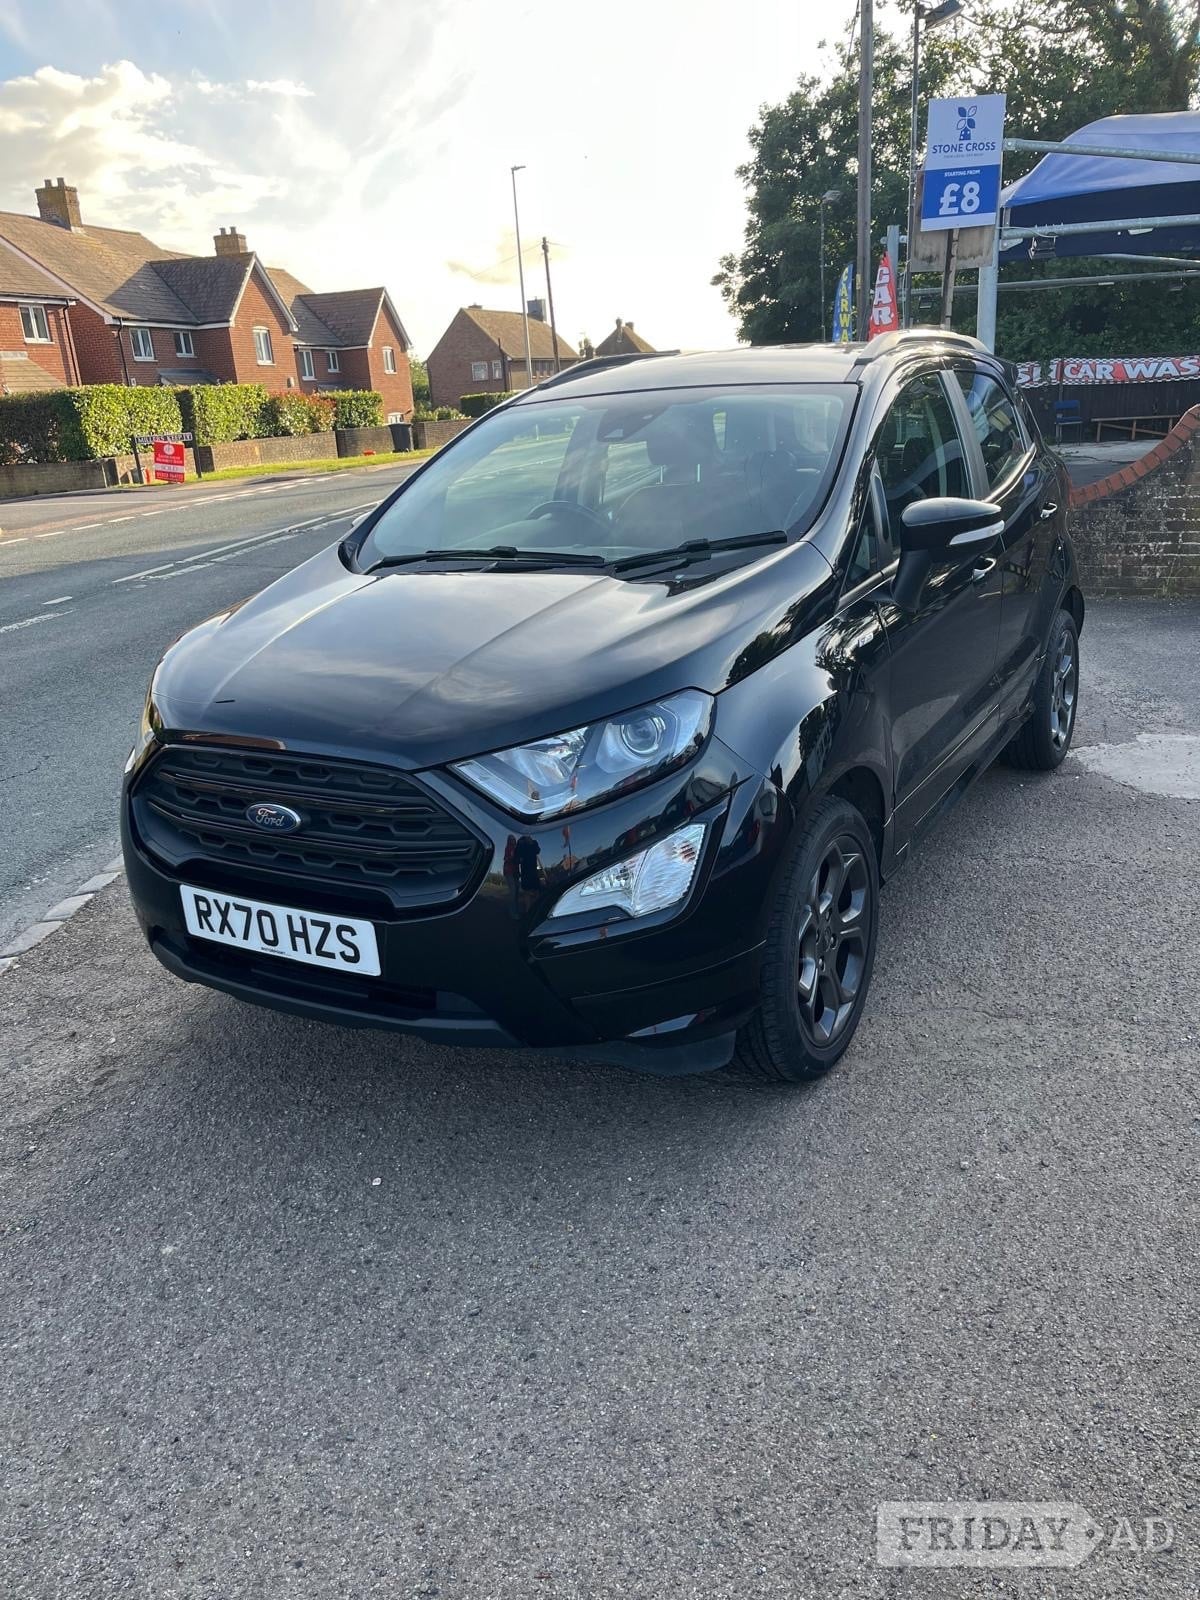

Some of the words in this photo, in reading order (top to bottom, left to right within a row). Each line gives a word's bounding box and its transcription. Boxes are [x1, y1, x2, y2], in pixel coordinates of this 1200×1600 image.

[932, 143, 964, 154] STONE
[965, 141, 996, 152] CROSS
[939, 181, 980, 215] £8
[873, 266, 892, 326] CAR
[1063, 362, 1114, 380] CAR
[255, 807, 285, 827] Ford
[193, 893, 279, 947] RX70
[286, 914, 361, 964] HZS
